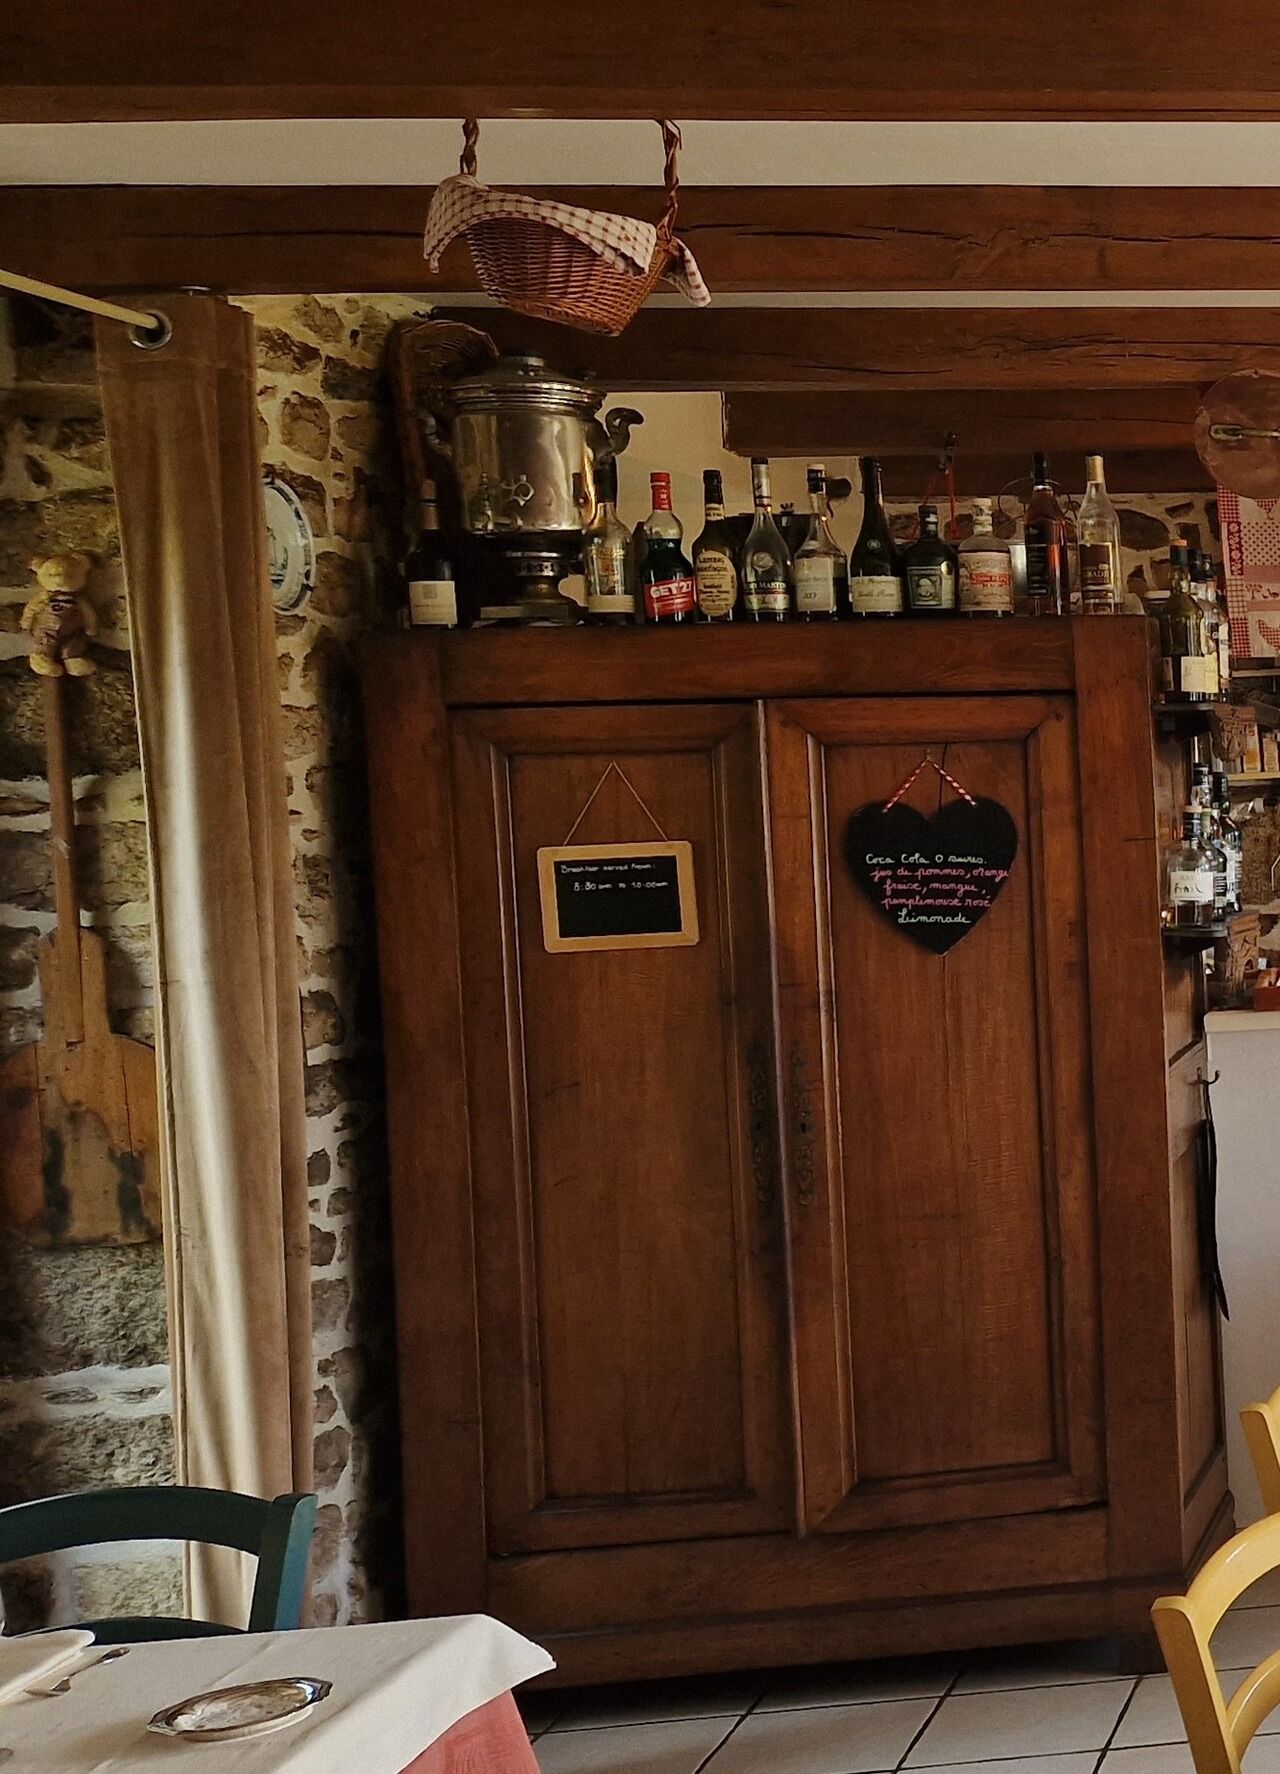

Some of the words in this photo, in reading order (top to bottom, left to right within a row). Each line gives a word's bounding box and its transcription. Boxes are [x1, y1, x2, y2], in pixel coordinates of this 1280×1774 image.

[650, 582, 679, 599] GET
[679, 580, 692, 593] 27
[866, 853, 895, 864] Coca
[901, 852, 930, 864] Cola
[870, 867, 892, 882] jus
[897, 867, 912, 876] de
[897, 907, 971, 924] Limonade
